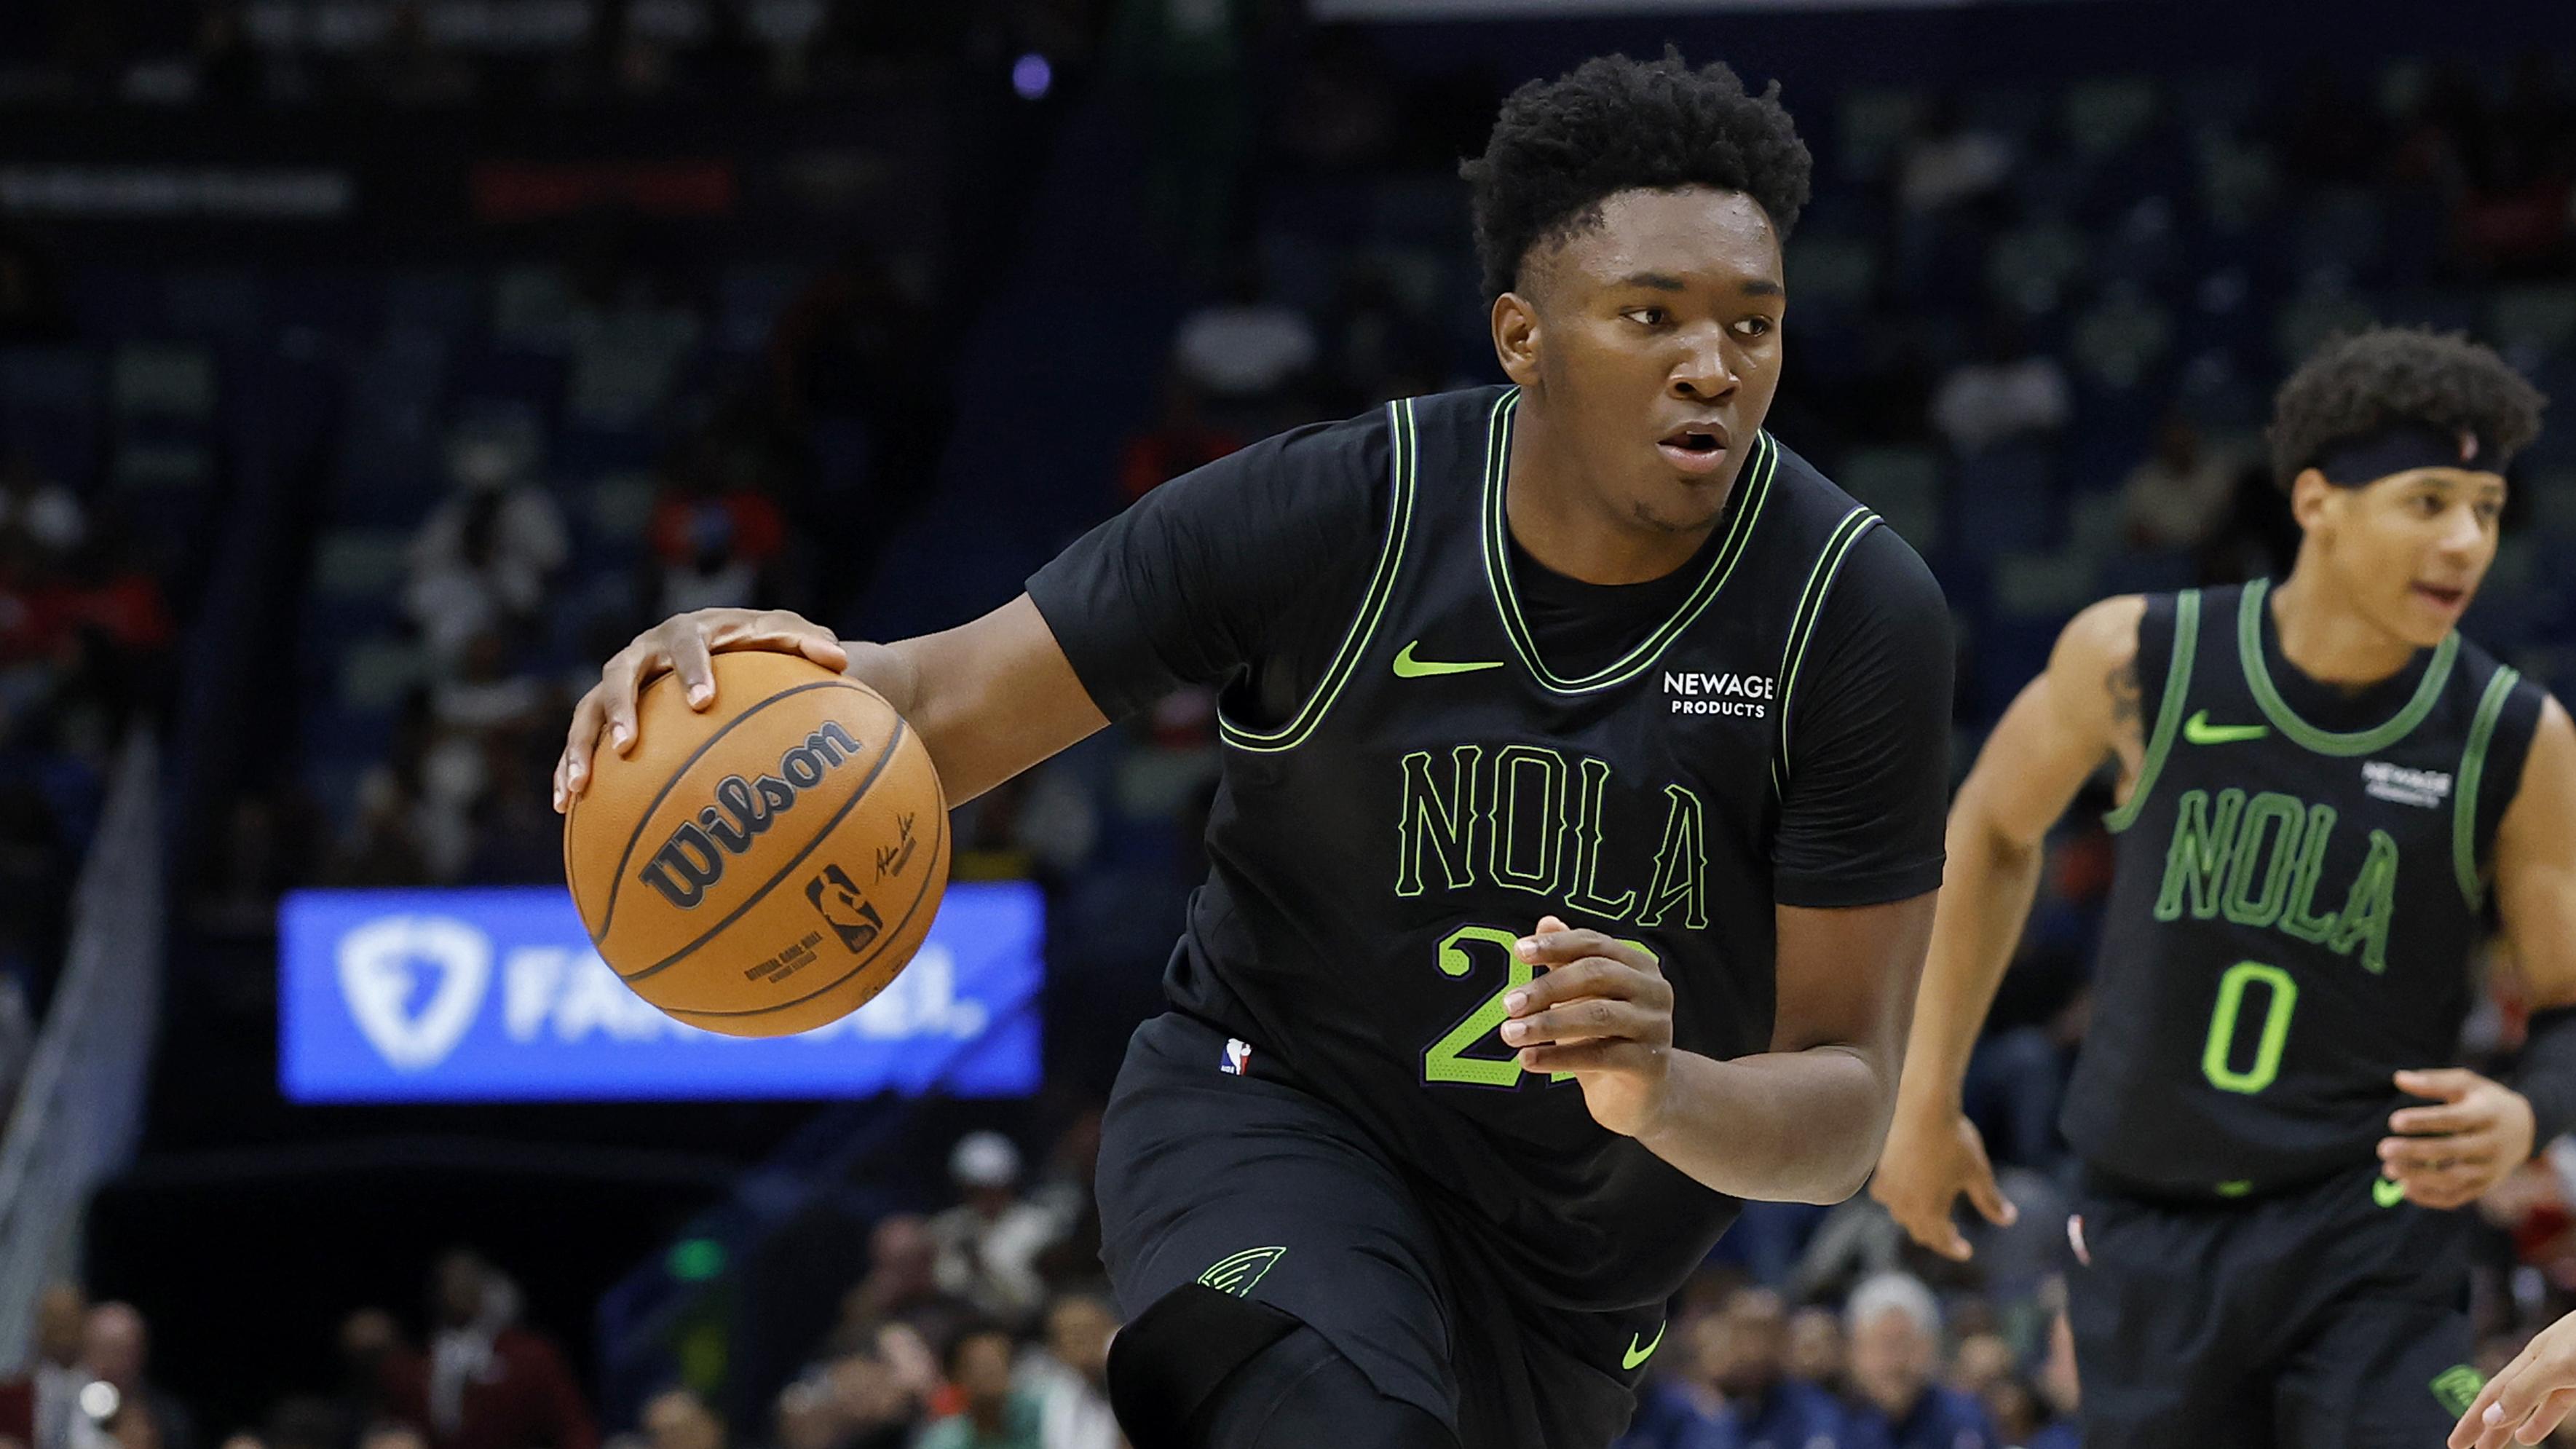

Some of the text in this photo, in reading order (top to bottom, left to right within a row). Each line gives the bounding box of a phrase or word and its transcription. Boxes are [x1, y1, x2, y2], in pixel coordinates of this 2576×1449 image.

[1663, 671, 1774, 700] NEWAGE
[1671, 700, 1766, 719] PRODUCTS
[638, 719, 863, 910] Wilson
[1395, 744, 1708, 930] NOLA
[2154, 789, 2399, 974] NOLA
[1420, 922, 1661, 1087] 2
[2202, 960, 2299, 1094] 0
